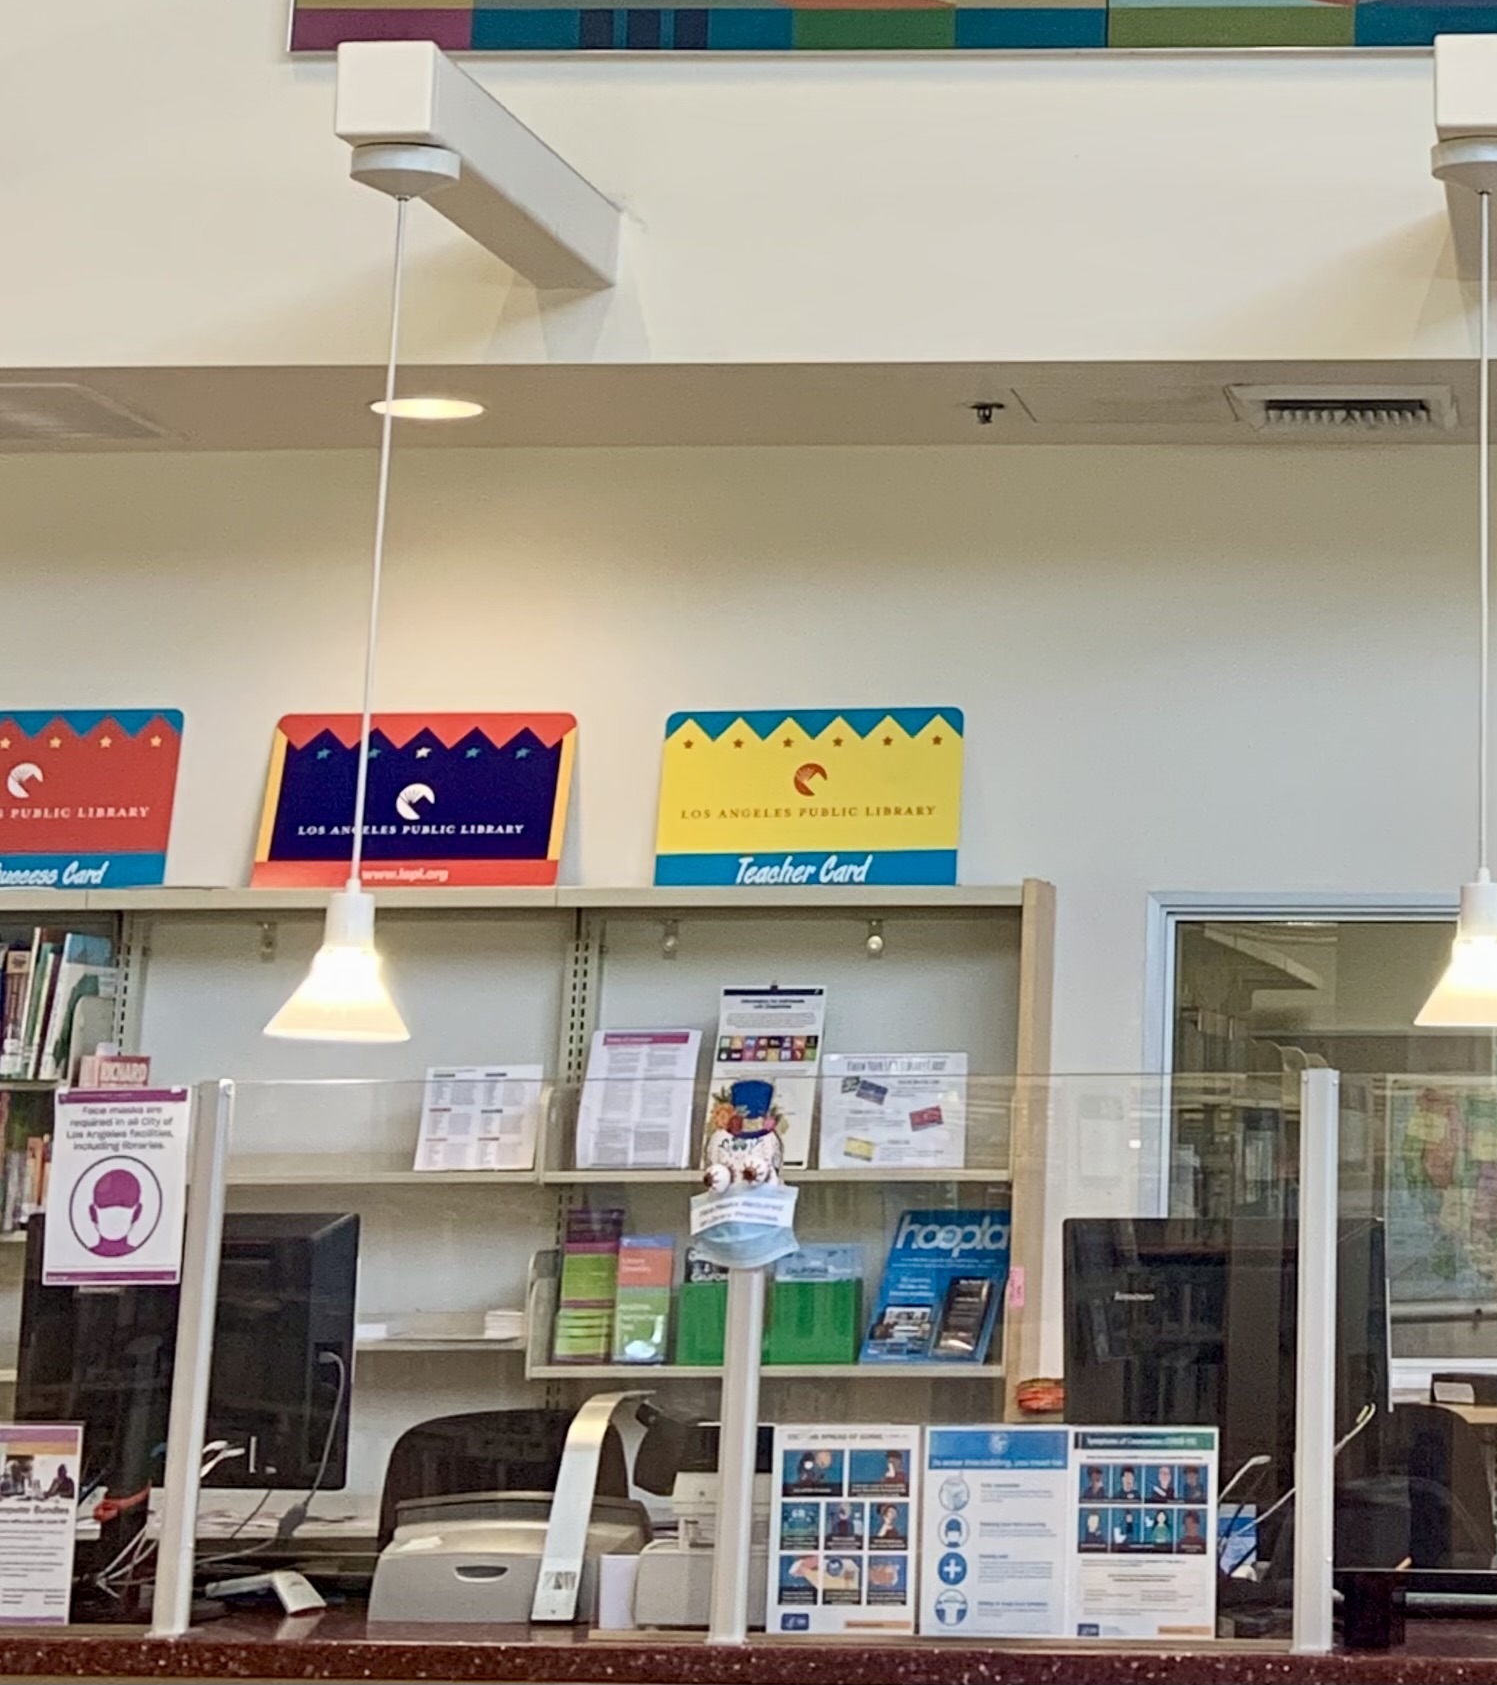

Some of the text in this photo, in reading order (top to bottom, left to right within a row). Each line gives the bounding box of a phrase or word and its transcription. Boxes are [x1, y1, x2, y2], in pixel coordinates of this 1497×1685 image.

[10, 807, 71, 819] PUBLIC
[77, 805, 150, 819] LIBRARY
[681, 805, 937, 820] LOS ANGELES PUBLIC LIBRARY
[297, 824, 326, 836] LOS
[401, 823, 456, 835] PUBLIC
[460, 823, 525, 835] LIBRARY
[62, 860, 110, 886] Card
[735, 853, 874, 885] Teacher Card
[69, 1118, 113, 1128] required
[141, 1117, 160, 1128] City
[66, 1131, 84, 1139] Los
[86, 1130, 127, 1141] Angeles
[73, 1142, 120, 1152] including
[895, 1214, 1011, 1258] hoopla
